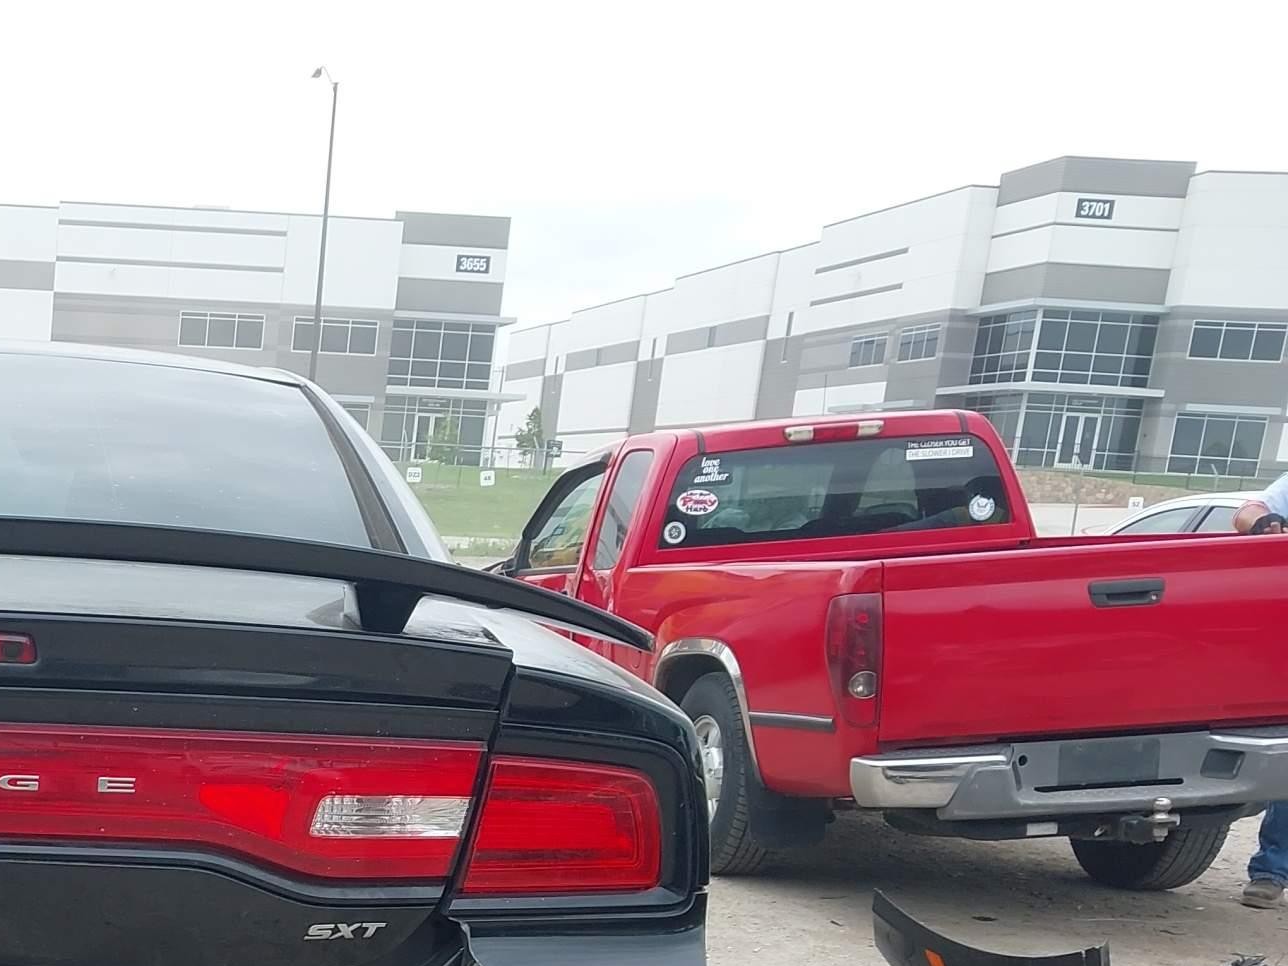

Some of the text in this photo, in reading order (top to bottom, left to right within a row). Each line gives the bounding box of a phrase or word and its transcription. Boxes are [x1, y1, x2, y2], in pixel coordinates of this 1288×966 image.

[1080, 201, 1111, 217] 3701
[459, 257, 487, 271] 3655
[958, 438, 970, 446] GET
[702, 466, 719, 474] one
[693, 471, 729, 483] another
[303, 922, 388, 940] SXT
